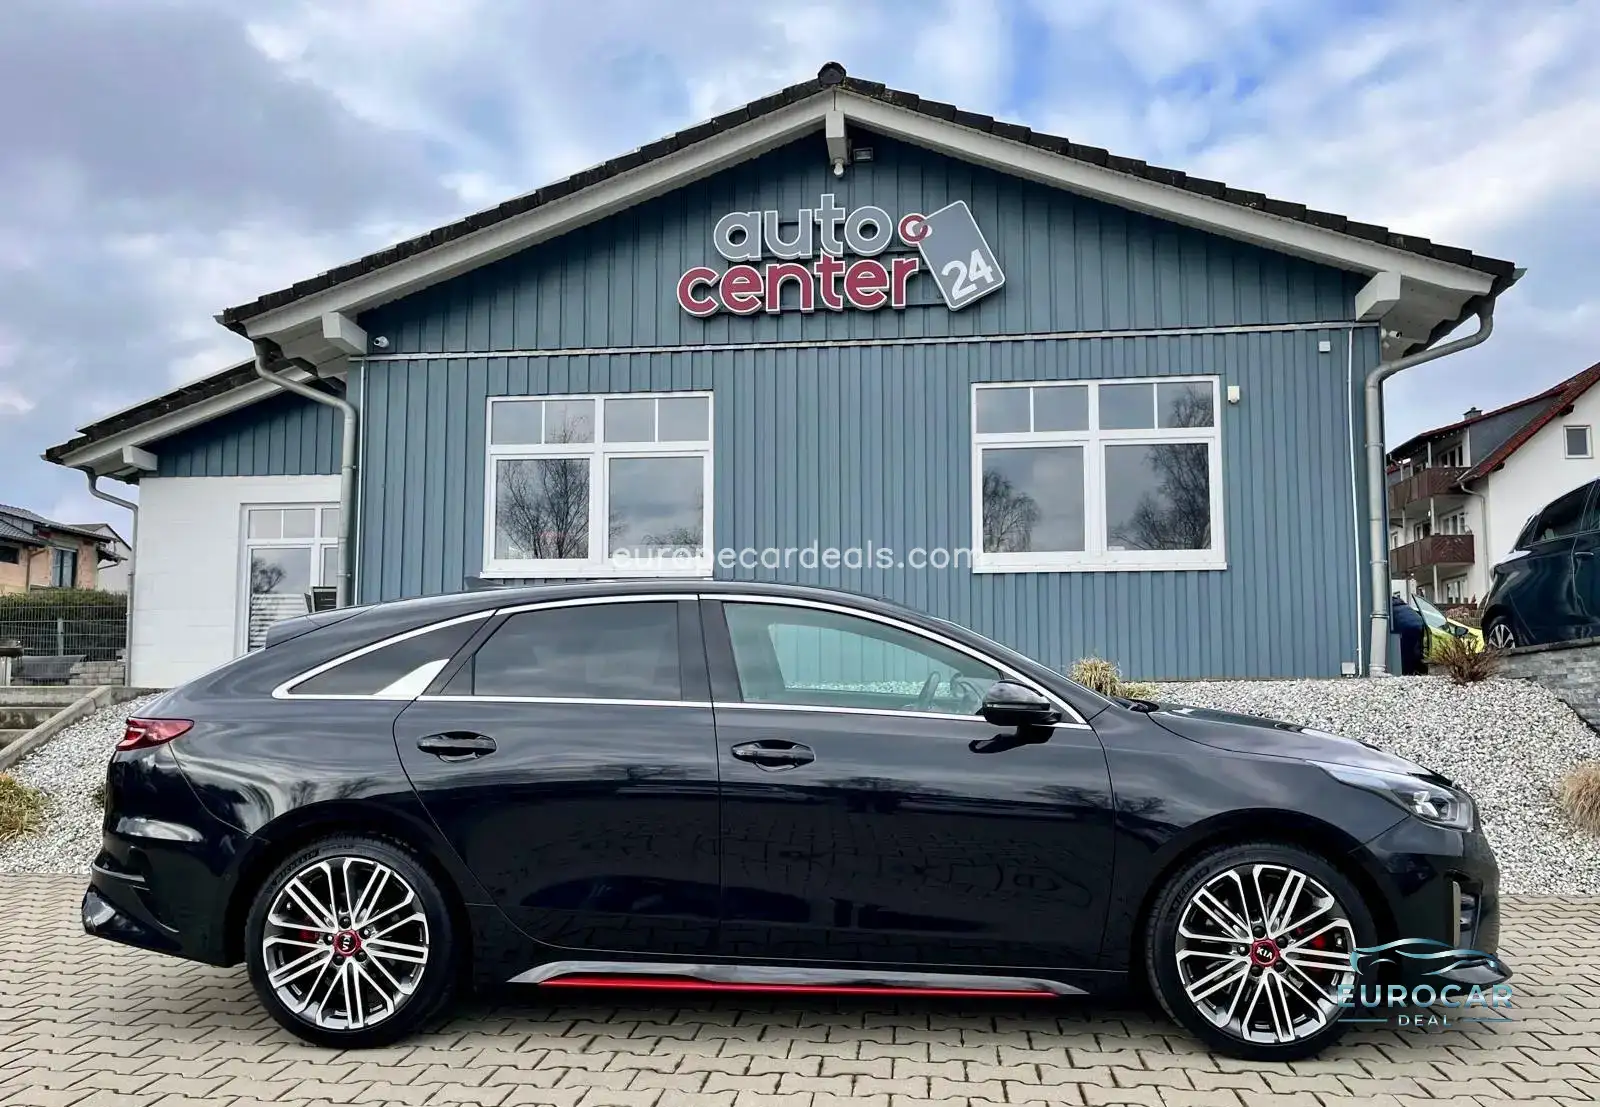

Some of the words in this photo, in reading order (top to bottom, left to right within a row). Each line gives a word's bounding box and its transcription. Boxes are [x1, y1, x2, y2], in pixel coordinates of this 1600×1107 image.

[713, 193, 893, 262] auto
[676, 249, 919, 317] center
[941, 248, 994, 301] 24
[1256, 946, 1273, 960] KIA
